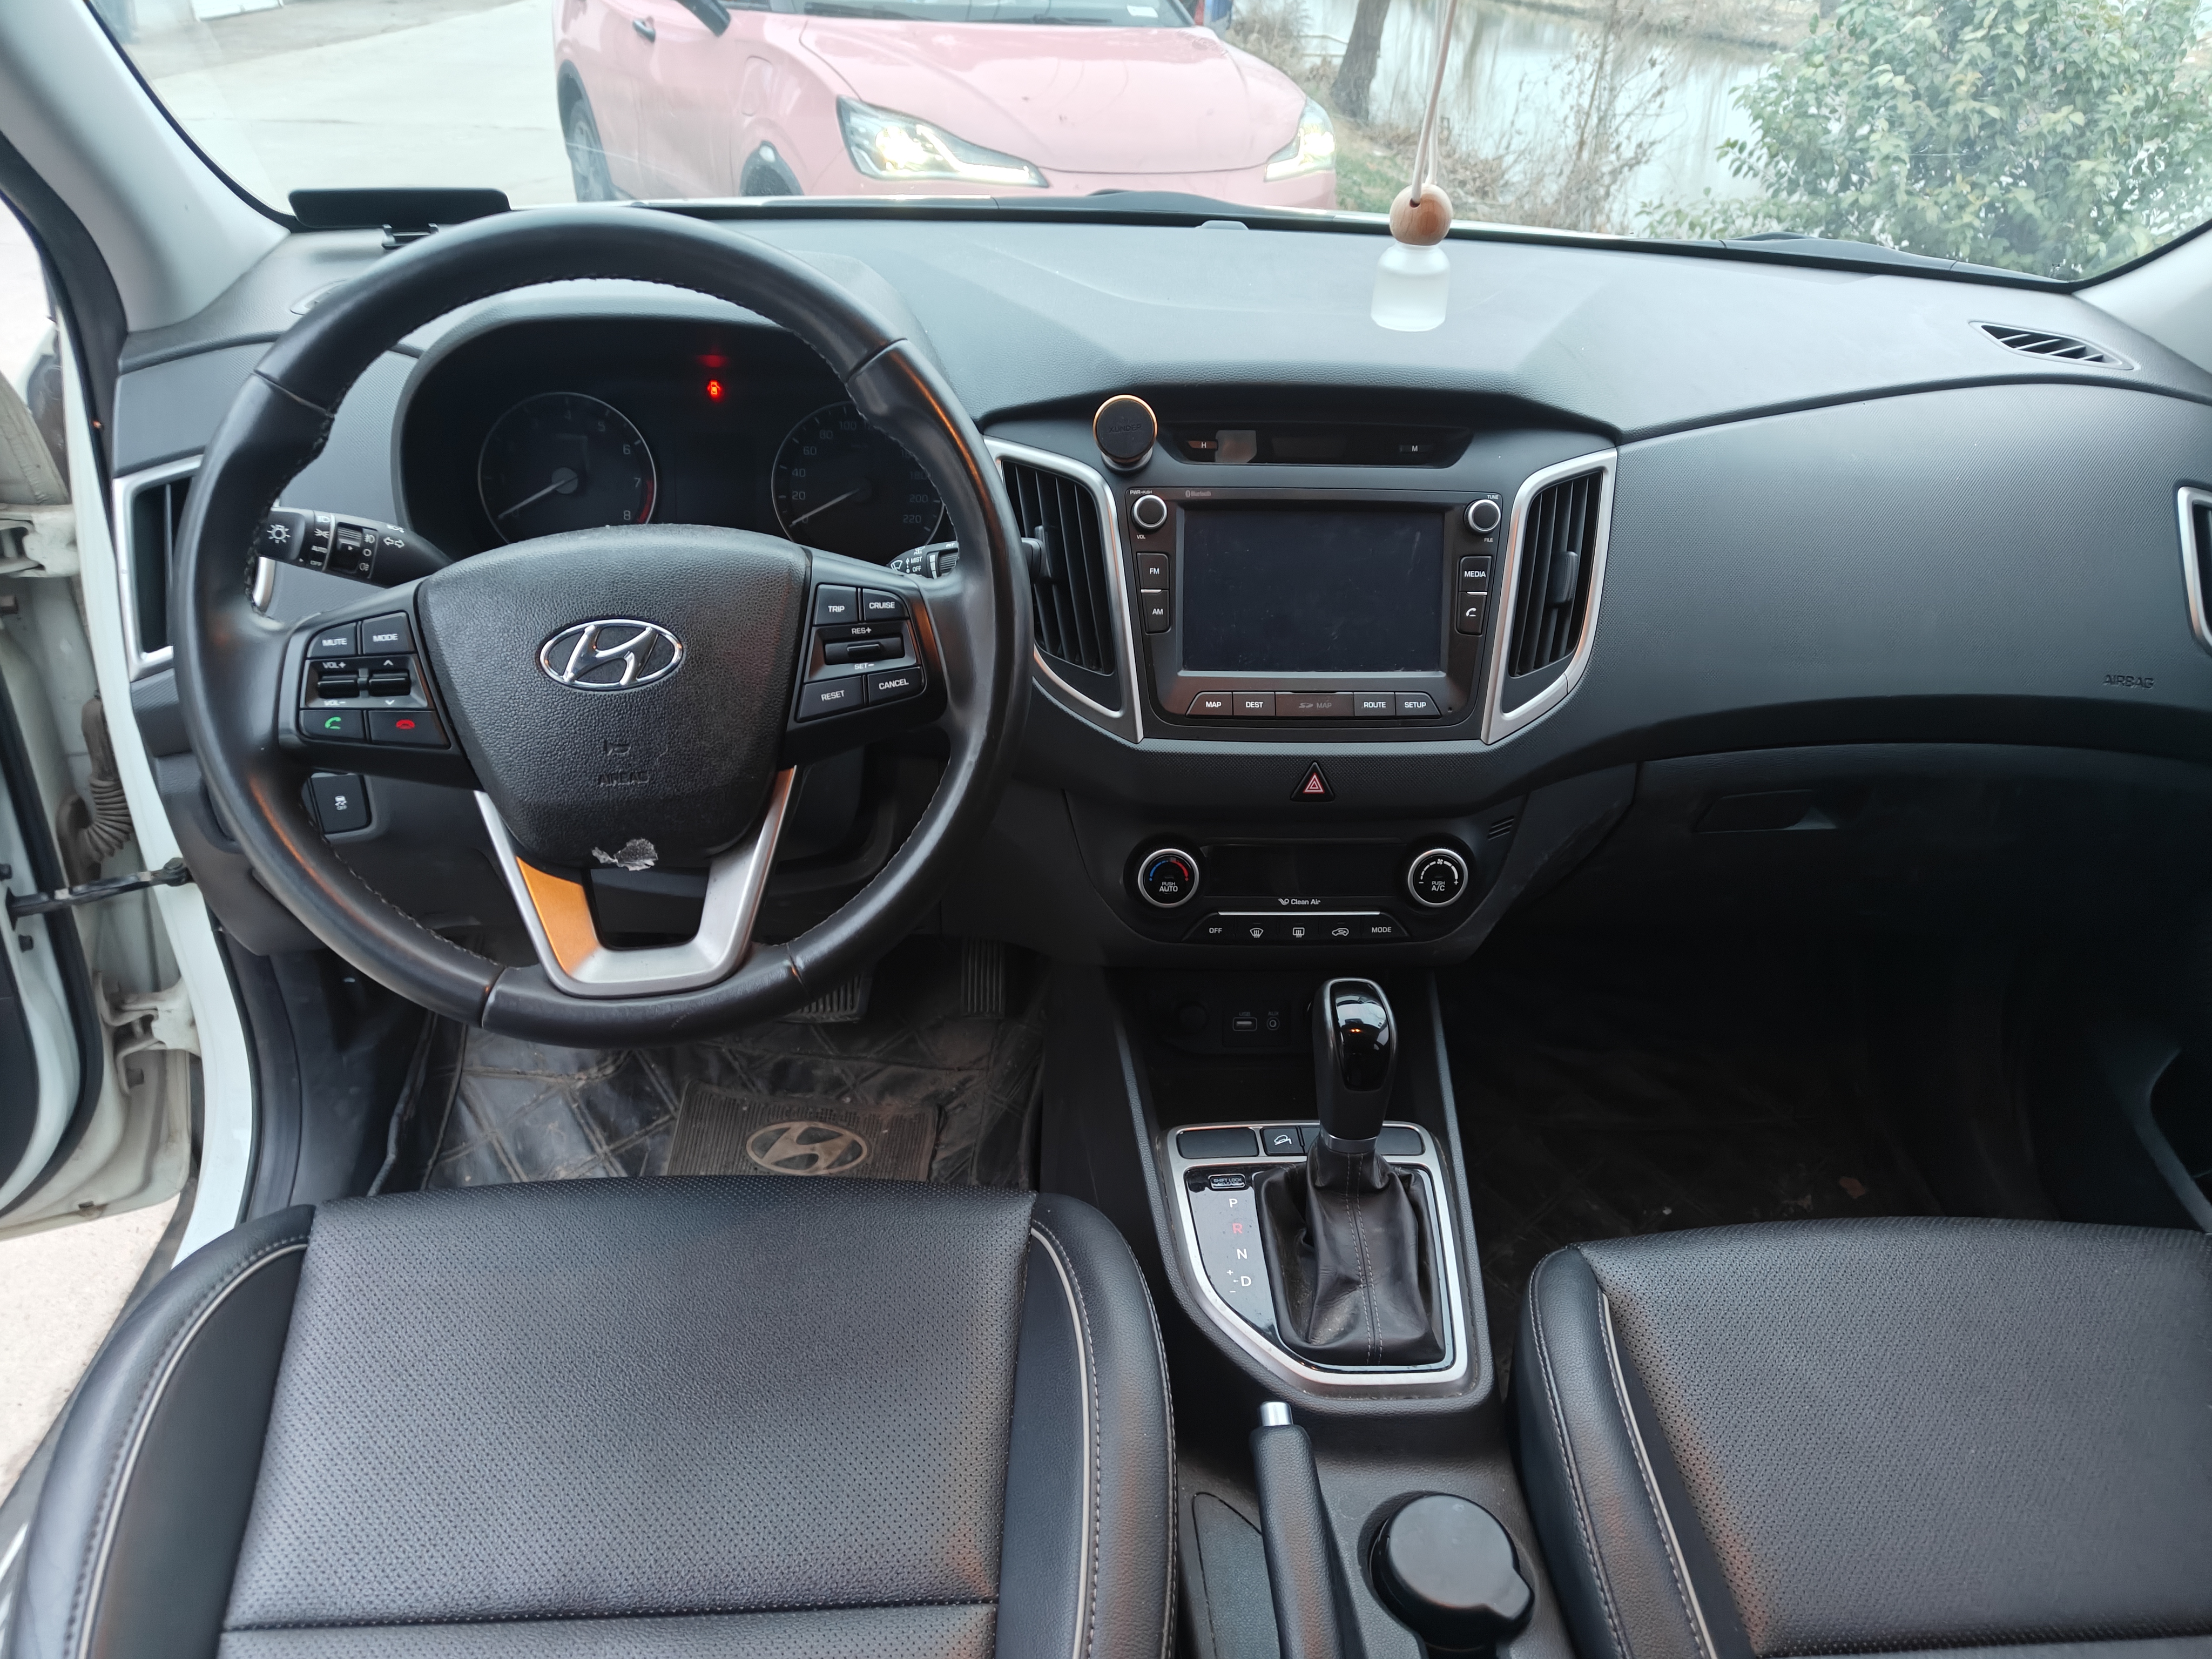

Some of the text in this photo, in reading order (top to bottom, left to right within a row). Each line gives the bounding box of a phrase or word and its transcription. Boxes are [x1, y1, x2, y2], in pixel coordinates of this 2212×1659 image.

[803, 446, 817, 455] 60
[791, 468, 806, 477] 40
[633, 477, 641, 488] 7
[792, 490, 806, 501] 20
[909, 494, 928, 504] 200
[623, 509, 631, 521] 8
[902, 515, 921, 524] 220
[1149, 567, 1160, 575] FM
[321, 637, 347, 646] MUTE
[372, 633, 399, 642] MODE
[878, 678, 909, 690] CANCEL
[2102, 674, 2154, 689] AIRBAG
[821, 690, 845, 702] RESET
[1228, 1198, 1238, 1208] P
[1232, 1222, 1243, 1234] R
[1236, 1248, 1248, 1260] N
[1240, 1275, 1252, 1287] D
